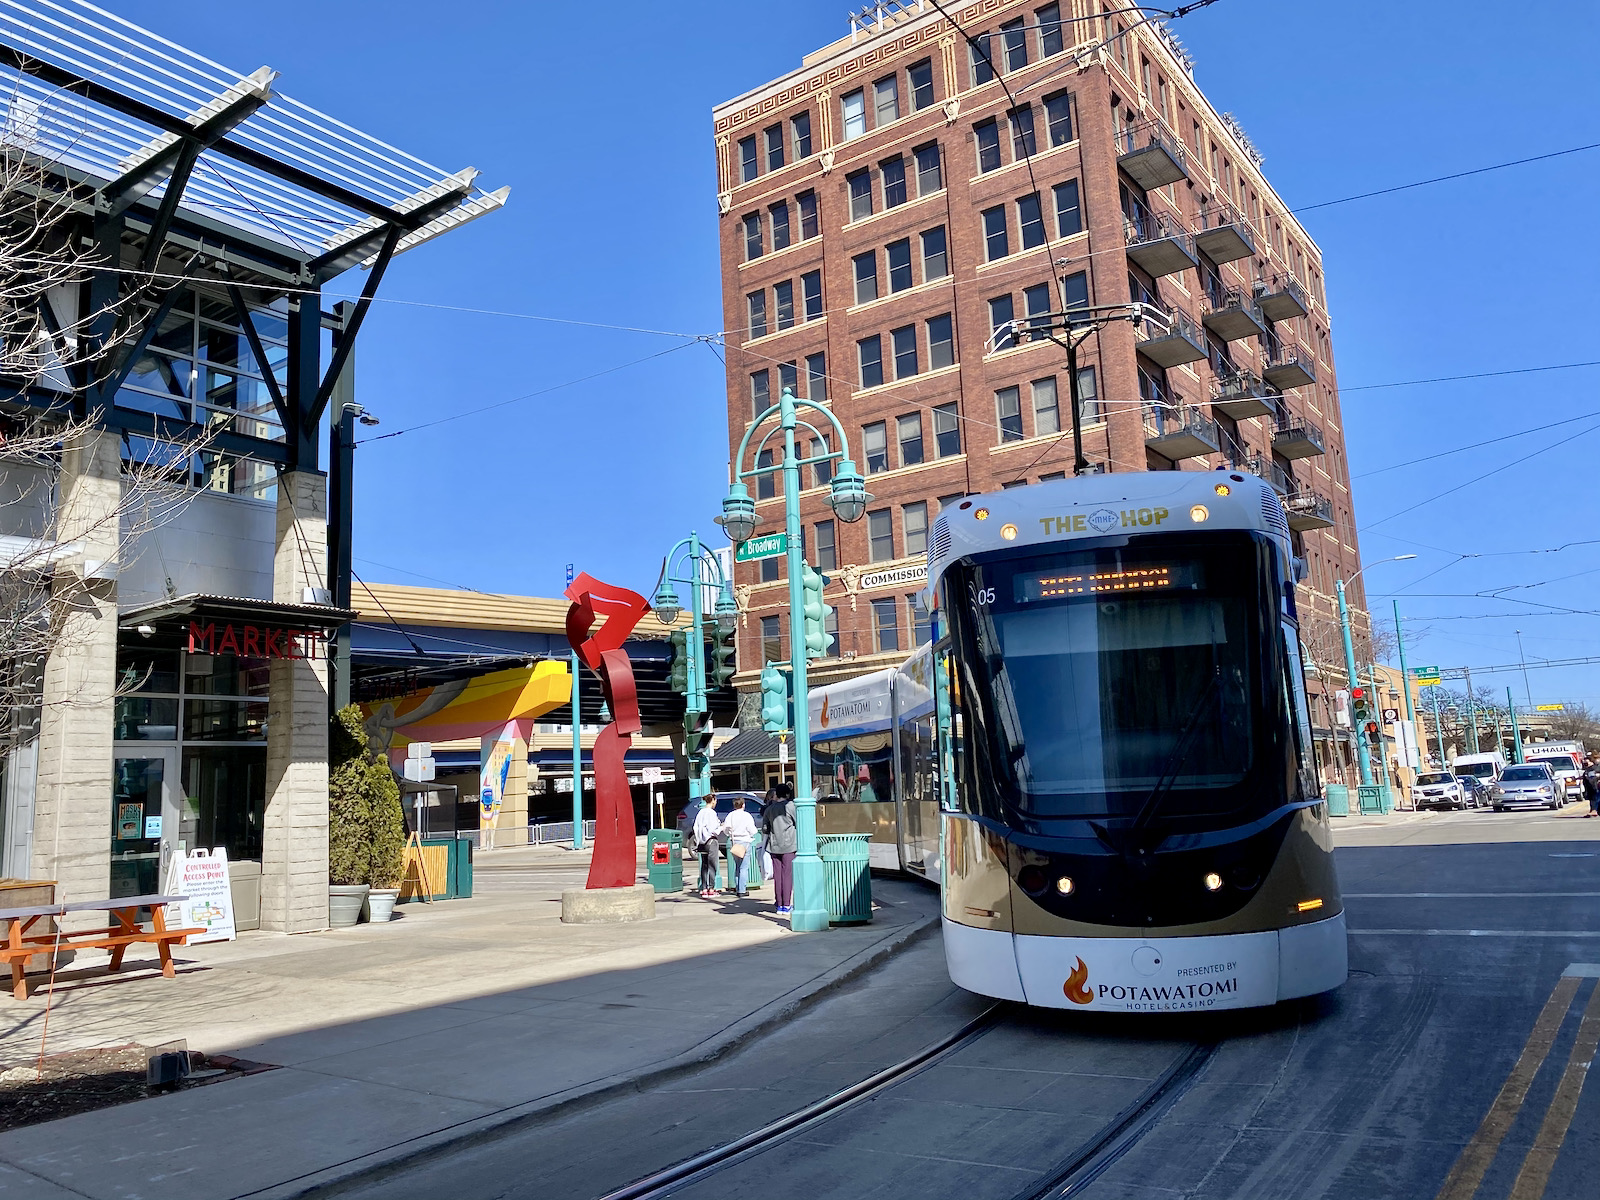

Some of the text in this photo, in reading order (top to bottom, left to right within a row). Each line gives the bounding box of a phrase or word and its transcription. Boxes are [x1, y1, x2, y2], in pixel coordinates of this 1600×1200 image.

[1039, 507, 1169, 536] THE HOP
[1095, 515, 1112, 524] MKE
[747, 537, 781, 554] Broadway
[978, 587, 996, 606] 05
[188, 620, 324, 661] MARKET
[830, 700, 871, 719] POTAWATOMI
[1531, 746, 1569, 755] U-HAUL
[183, 871, 224, 881] ACCESS POINT
[186, 863, 221, 872] CONTROLLED
[1177, 961, 1237, 977] PRESENTED BY
[1098, 978, 1237, 1001] POTAWATOMI
